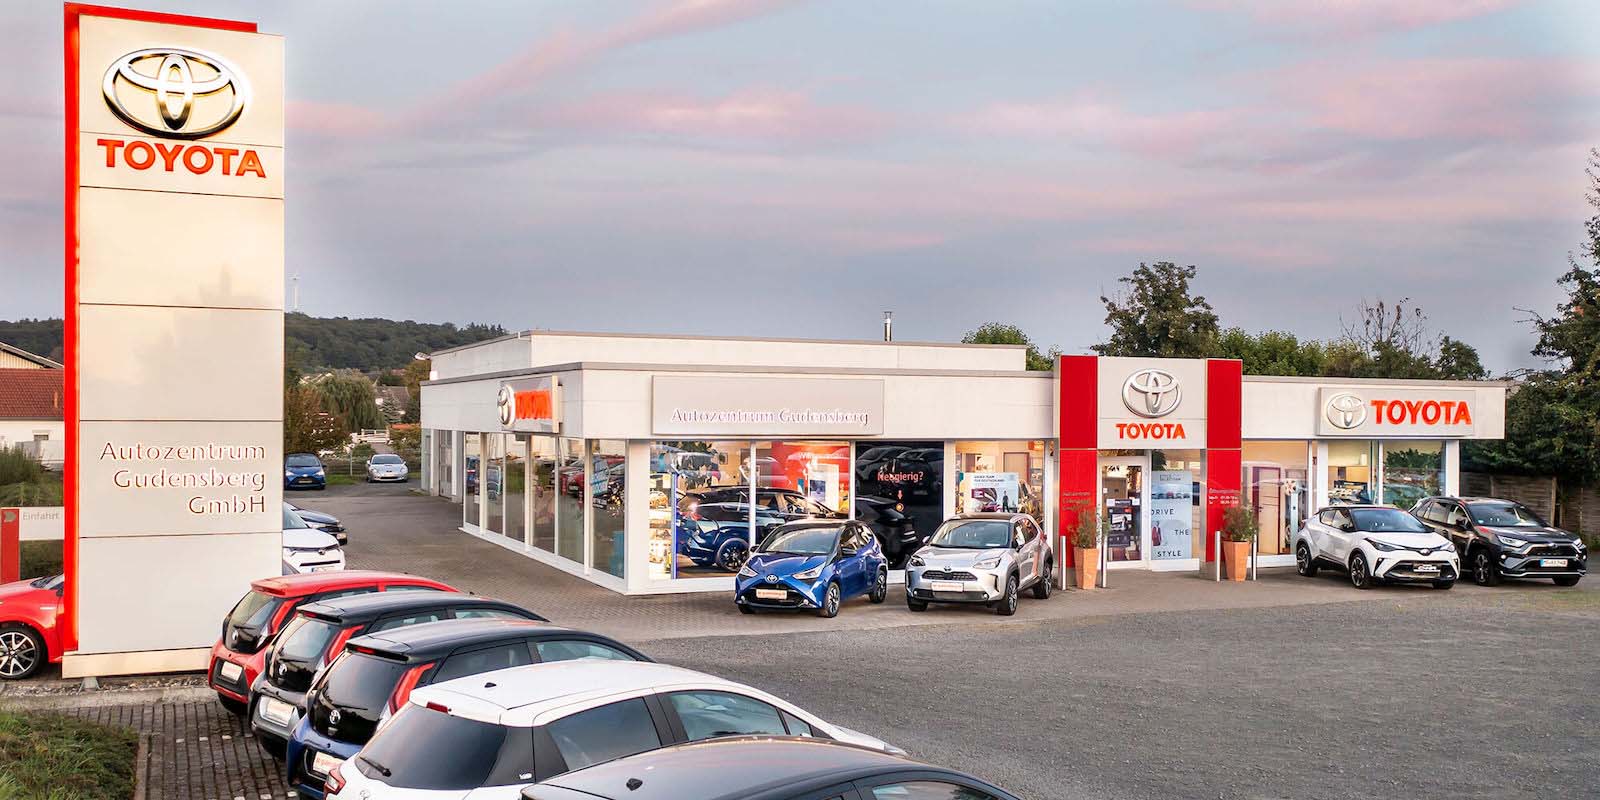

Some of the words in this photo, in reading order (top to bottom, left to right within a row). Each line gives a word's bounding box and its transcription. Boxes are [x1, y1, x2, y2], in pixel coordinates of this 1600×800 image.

[97, 138, 266, 178] TOYOTA
[671, 407, 774, 423] Autozentrum
[778, 407, 869, 426] Gudensberg
[1370, 399, 1473, 425] TOYOTA
[1115, 422, 1186, 439] TOYOTA
[100, 442, 265, 460] Autozentrum
[113, 468, 265, 492] Gudensberg
[188, 496, 265, 514] GmbH
[22, 511, 60, 521] Einfahrt
[1174, 528, 1190, 536] THE
